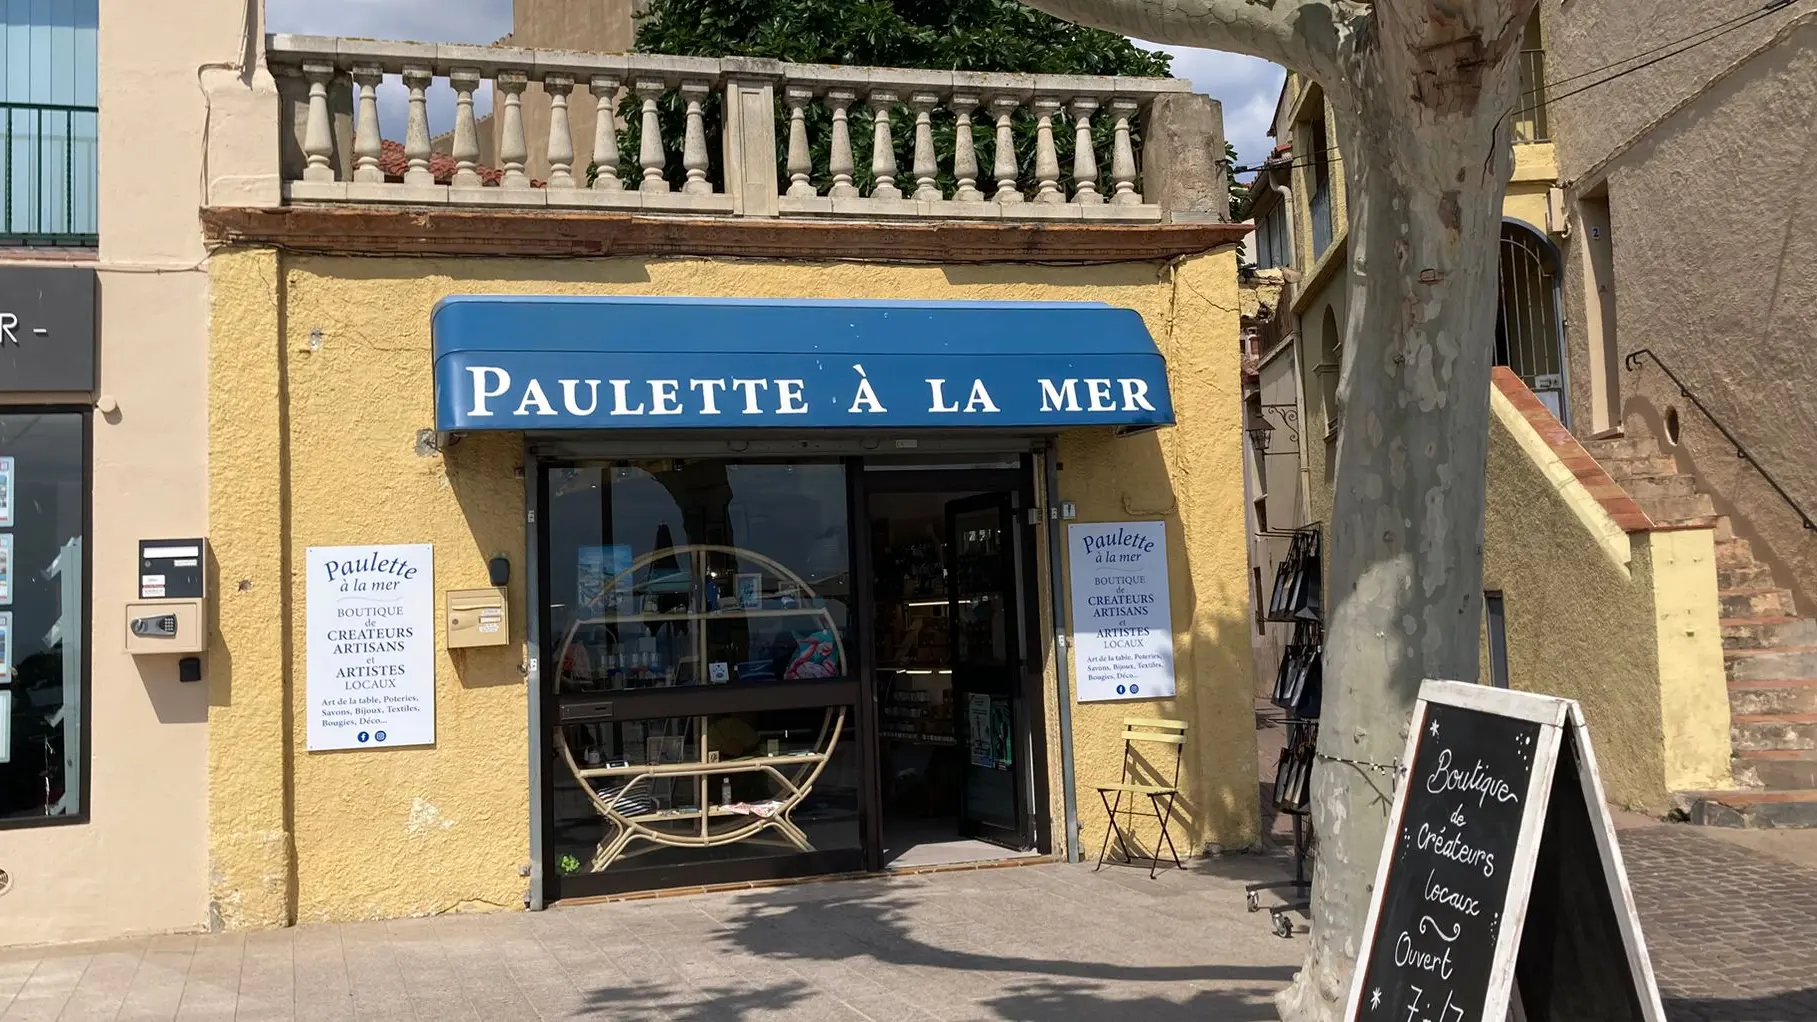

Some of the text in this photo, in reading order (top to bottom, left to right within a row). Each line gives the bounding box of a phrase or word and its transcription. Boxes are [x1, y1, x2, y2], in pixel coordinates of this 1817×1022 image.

[1592, 228, 1599, 238] 2
[465, 363, 1156, 417] PAULETTE À LA MER
[1083, 527, 1155, 554] Paulette
[1095, 551, 1141, 563] à la mer
[324, 551, 417, 582] Paulette
[340, 579, 400, 592] à la mer
[1094, 576, 1145, 586] BOUTIQUE
[1116, 586, 1125, 594] de
[1088, 594, 1154, 606] CREATEURS
[337, 606, 404, 618] BOUTIQUE
[1093, 606, 1149, 618] ARTISANS
[364, 618, 376, 628] de
[327, 627, 413, 641] CREATEURS
[1096, 626, 1150, 638] ARTISTES
[333, 641, 405, 654] ARTISANS
[1104, 639, 1144, 649] LOCAUX
[366, 657, 375, 665] et
[336, 665, 405, 678] ARTISTES
[345, 679, 396, 690] LOCAUX
[322, 698, 335, 707] Art
[337, 697, 347, 705] de
[349, 697, 357, 705] la
[1426, 748, 1518, 808] Boutique
[1450, 803, 1467, 827] de
[1417, 822, 1495, 878] Créateurs
[1395, 931, 1454, 980] Ouvert
